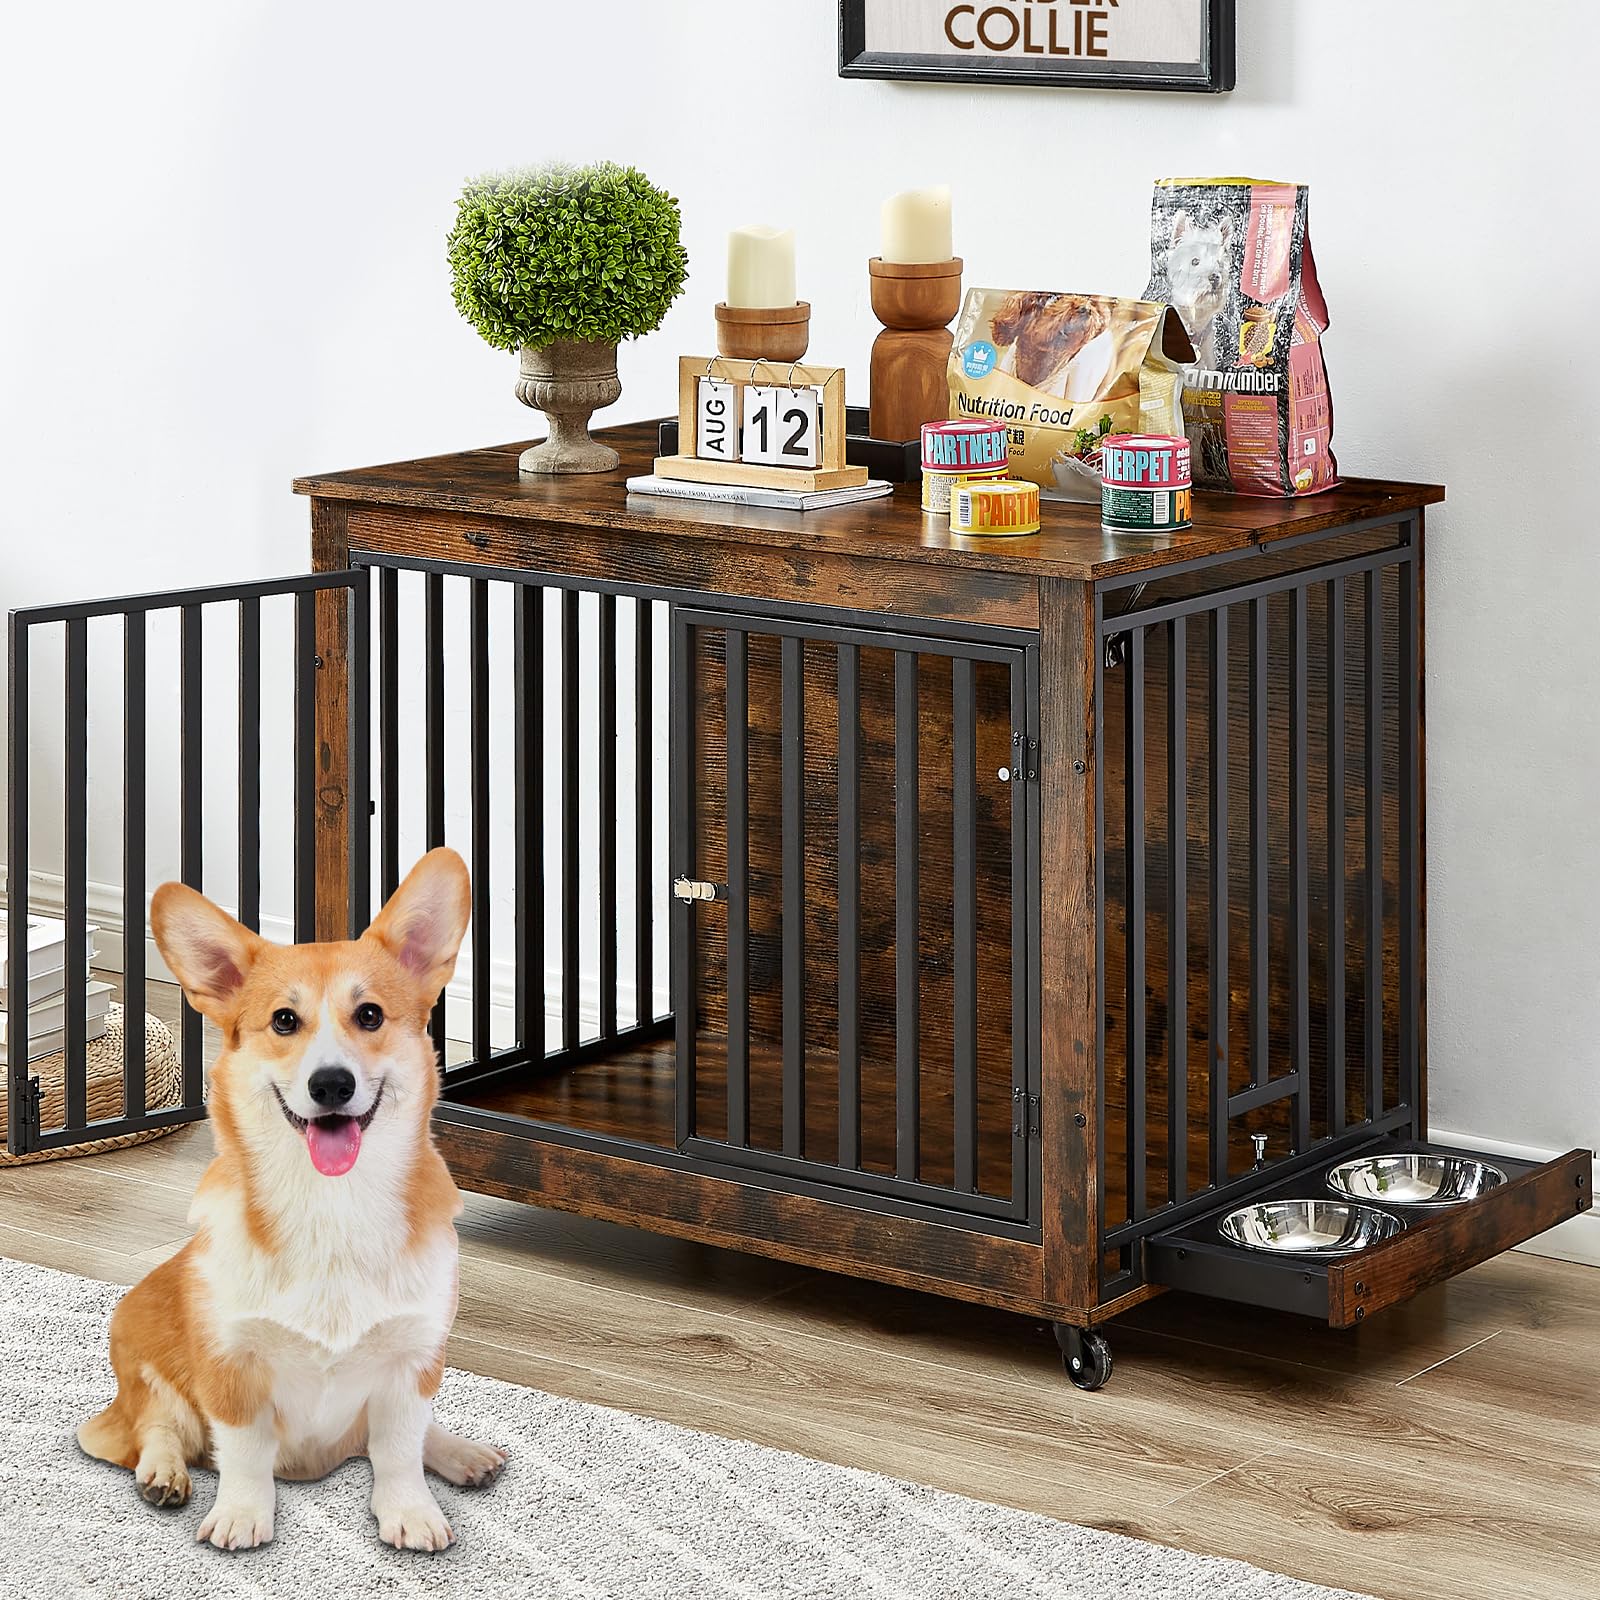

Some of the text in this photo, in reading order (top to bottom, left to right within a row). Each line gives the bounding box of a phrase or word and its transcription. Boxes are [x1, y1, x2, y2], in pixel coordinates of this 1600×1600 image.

[944, 5, 1108, 57] COLLIE
[706, 400, 725, 453] AUG
[958, 391, 1074, 425] Nutrition Food
[1008, 447, 1025, 456] Food
